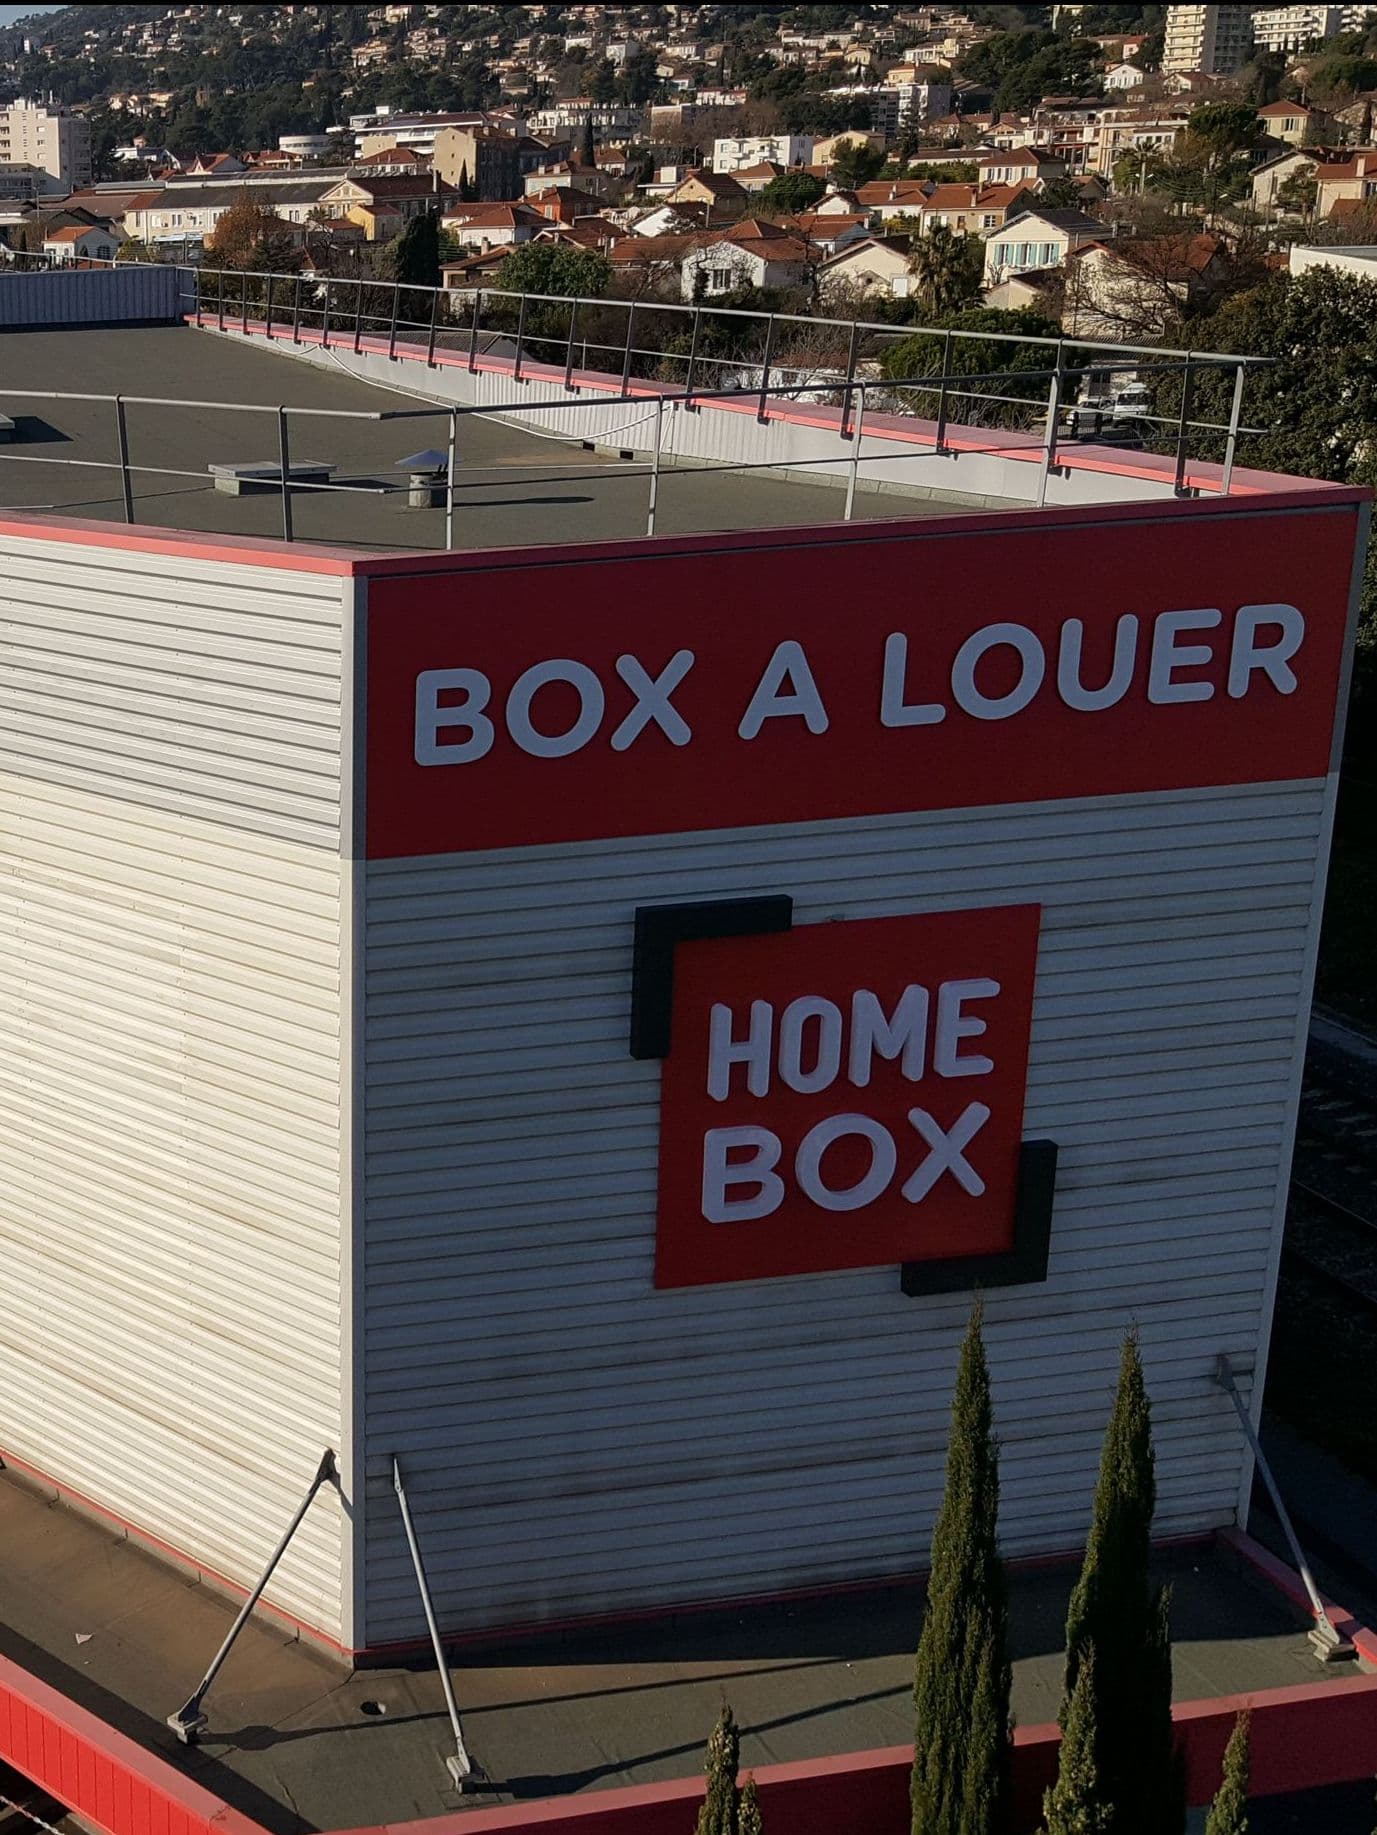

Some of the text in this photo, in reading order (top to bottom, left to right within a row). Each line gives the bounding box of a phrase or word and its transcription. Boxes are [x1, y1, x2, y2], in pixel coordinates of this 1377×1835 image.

[414, 603, 1305, 767] BOX A LOUER
[707, 978, 1000, 1101] HOME
[701, 1101, 991, 1224] BOX
